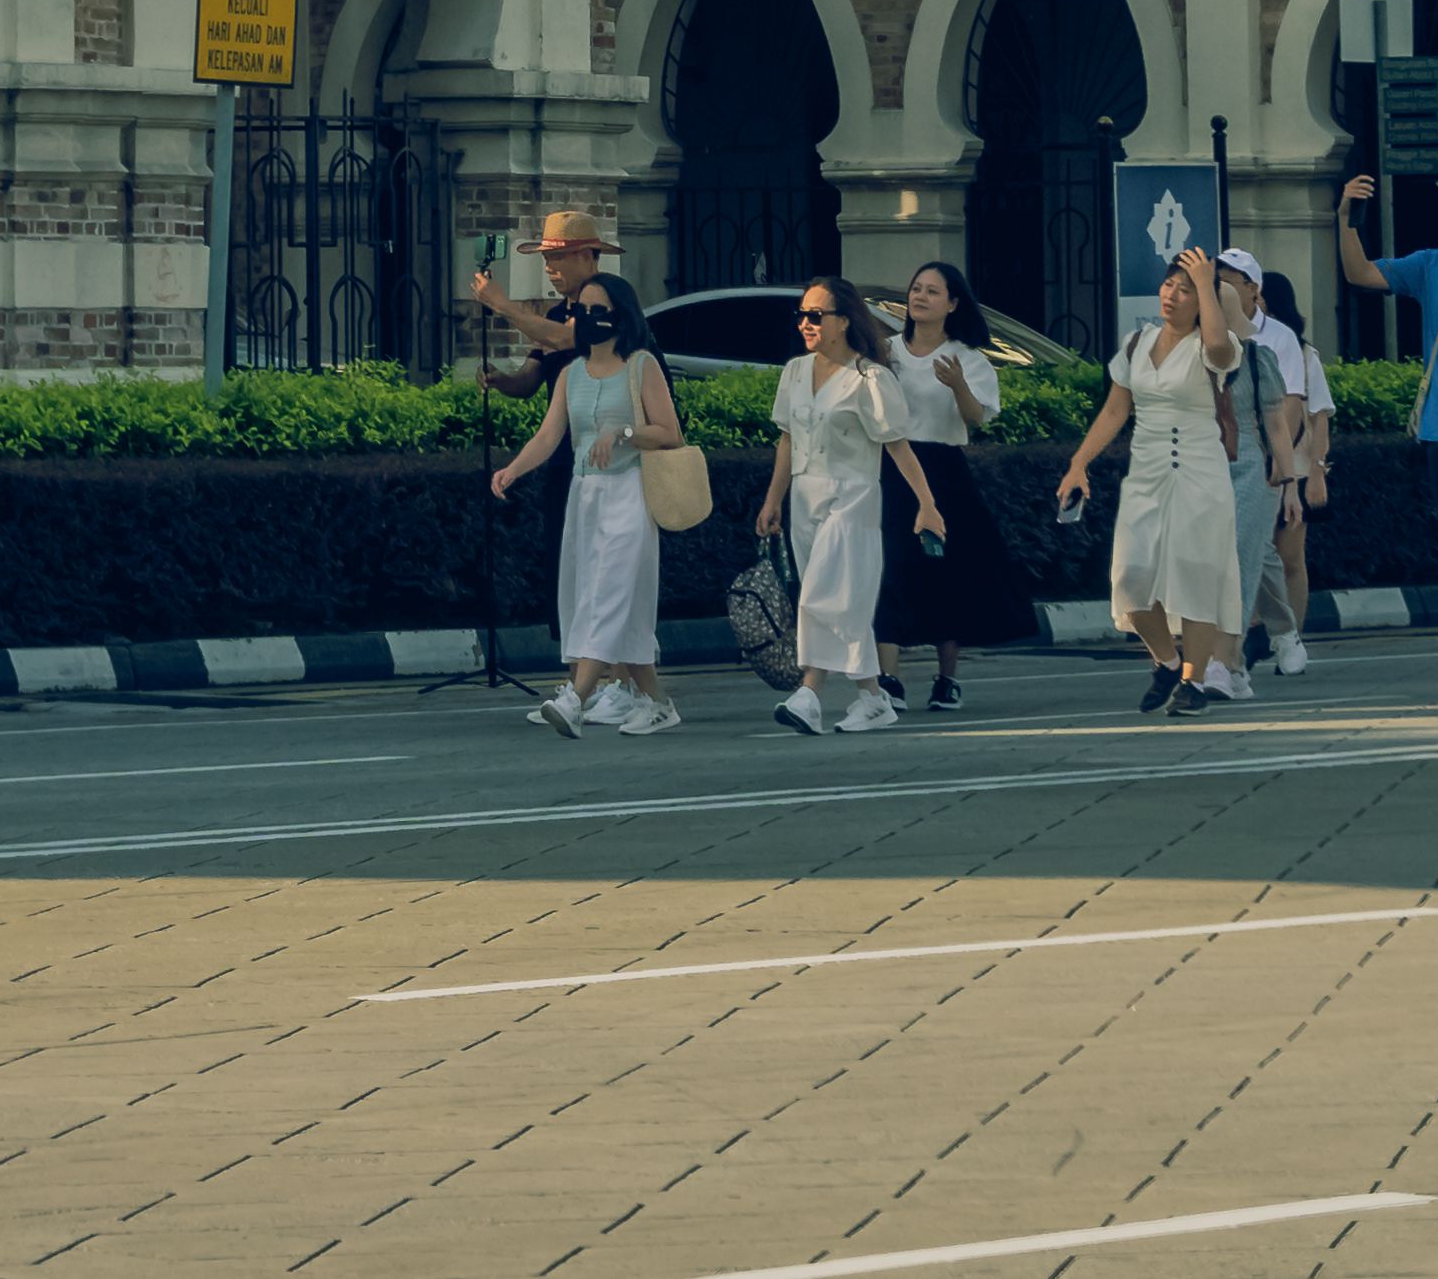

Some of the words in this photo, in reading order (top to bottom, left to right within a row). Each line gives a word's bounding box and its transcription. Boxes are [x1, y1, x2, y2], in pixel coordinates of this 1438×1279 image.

[208, 21, 230, 41] HARI
[236, 24, 261, 44] AHAD
[267, 26, 286, 46] DAN
[207, 49, 263, 73] KELEPASAN
[269, 55, 282, 74] AM
